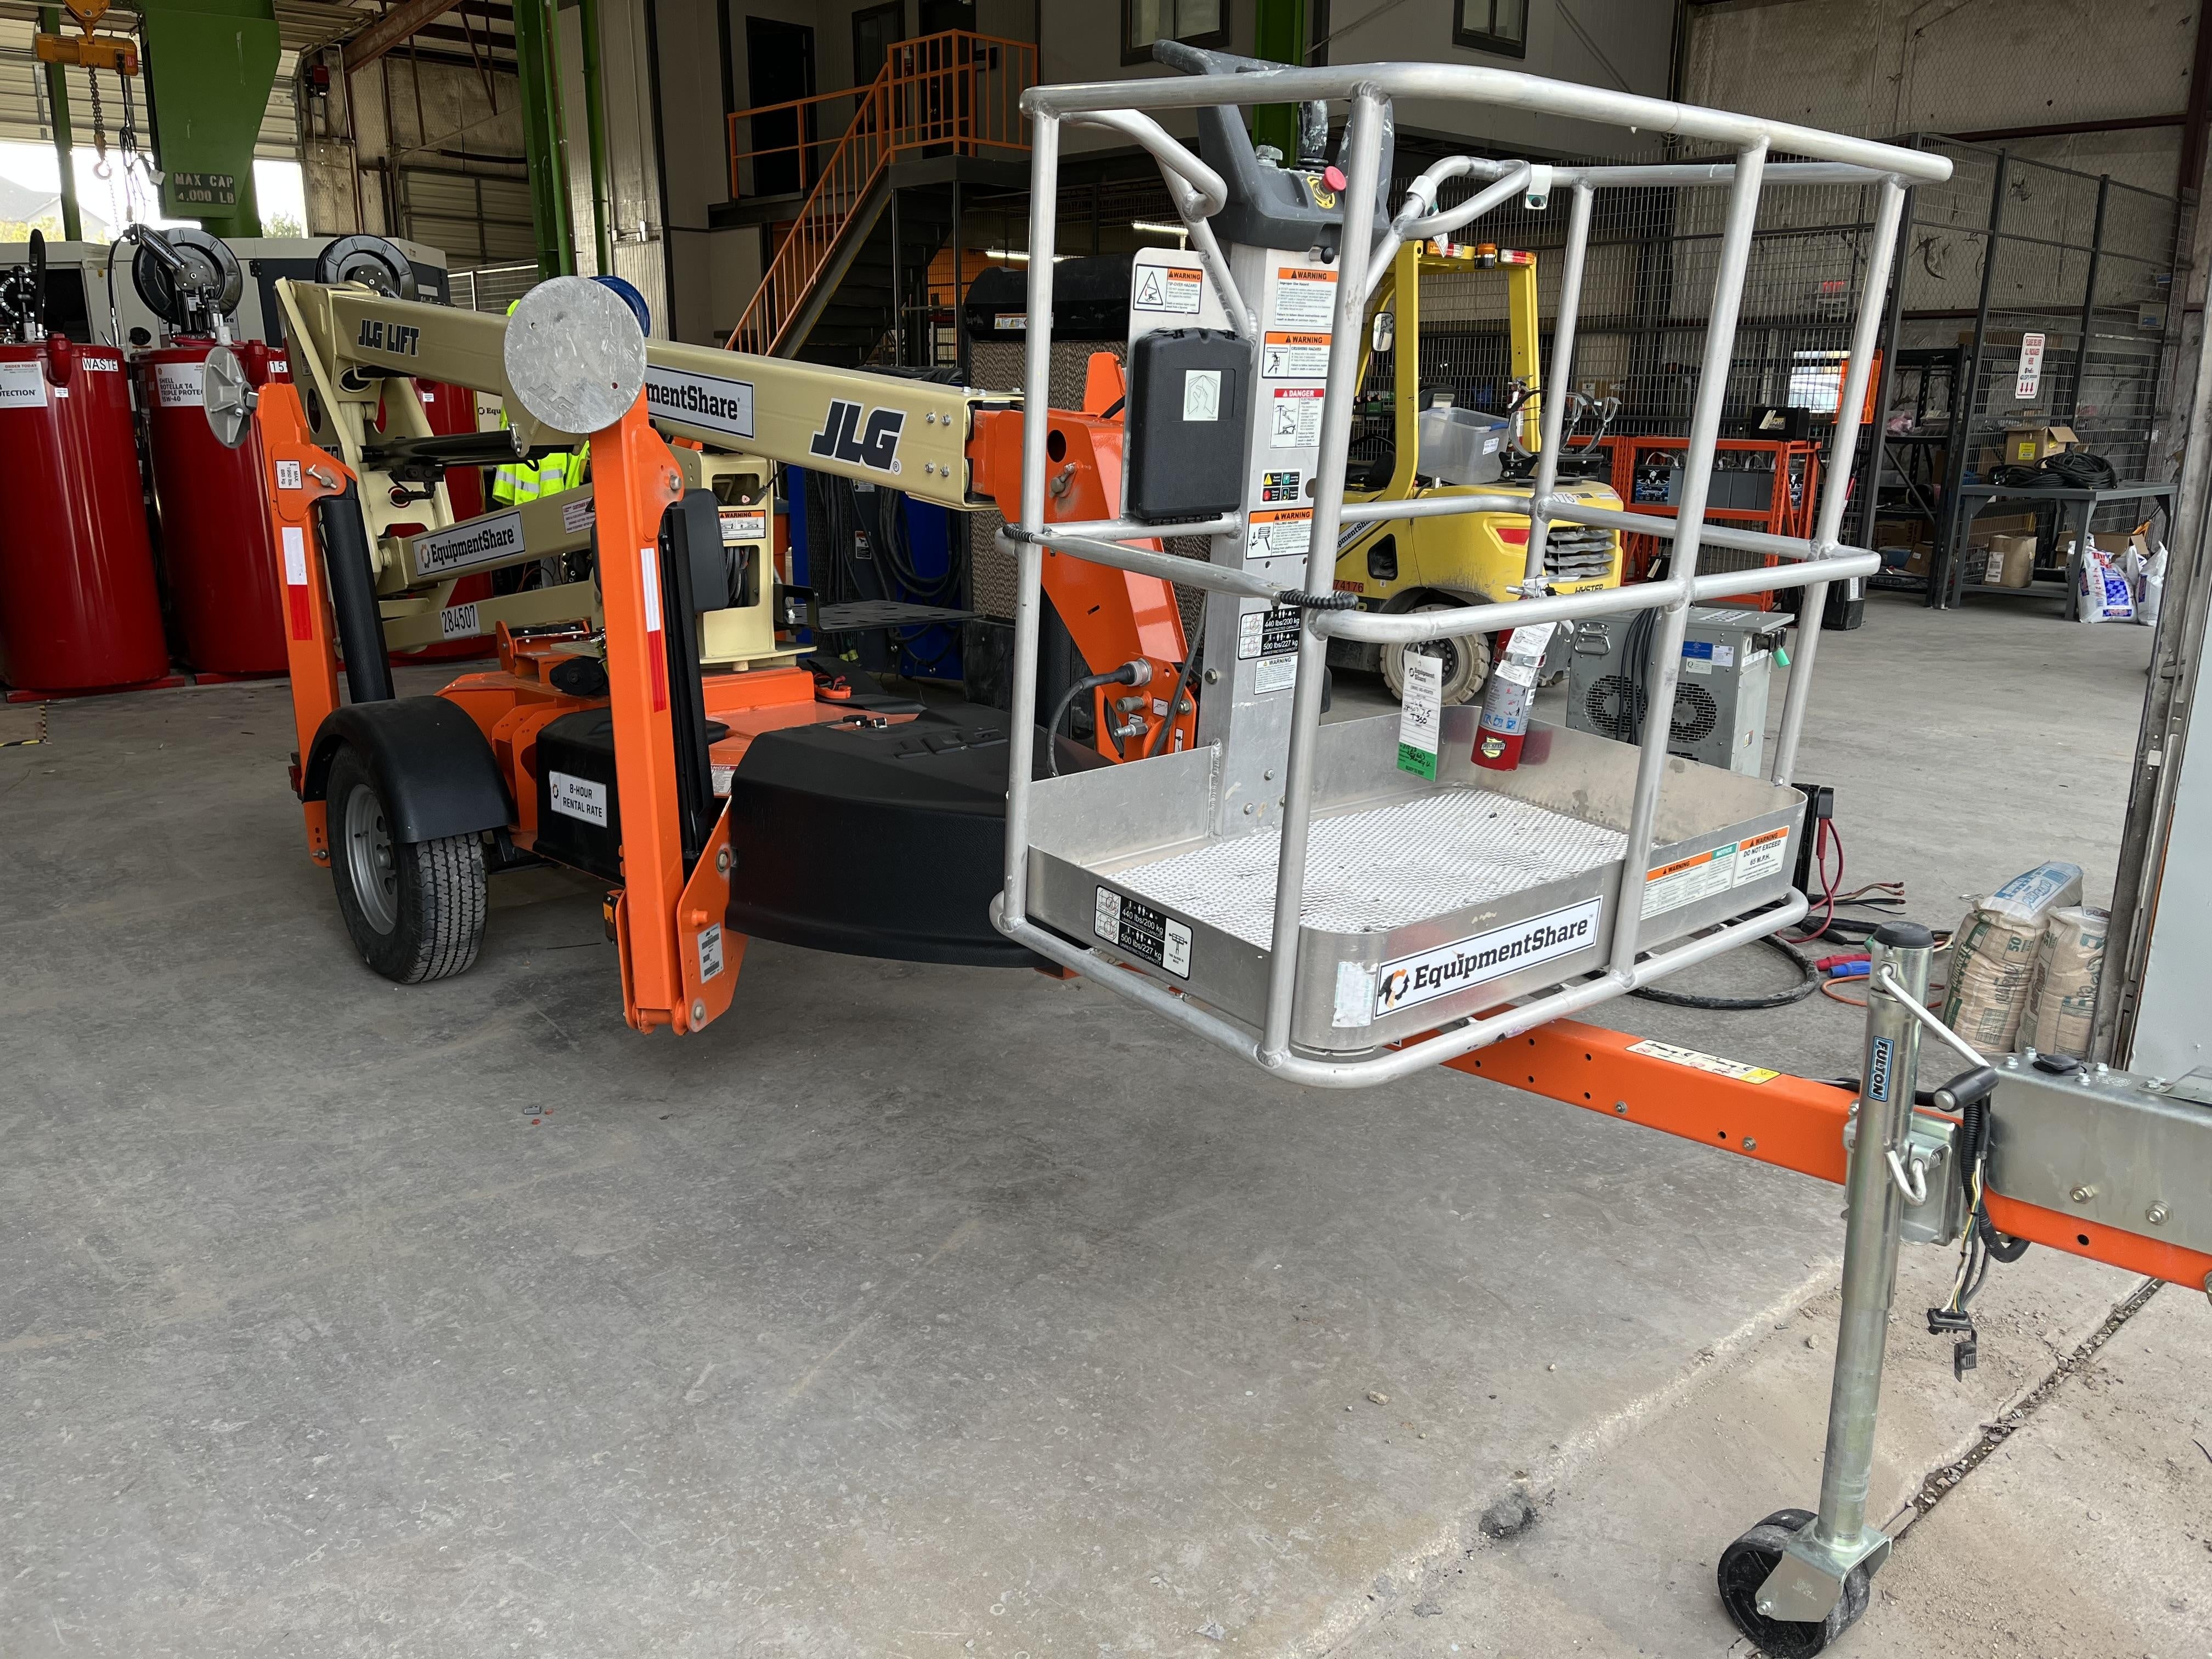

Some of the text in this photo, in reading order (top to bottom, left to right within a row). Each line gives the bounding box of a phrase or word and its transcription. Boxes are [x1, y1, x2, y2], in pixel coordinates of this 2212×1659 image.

[176, 173, 233, 187] MAX CAP
[219, 191, 234, 204] LB
[1298, 272, 1327, 280] WARNING
[358, 320, 420, 356] JLG LIFT
[83, 360, 117, 370] WASTE
[811, 401, 904, 470] JLG
[1281, 511, 1310, 520] WARNING
[430, 529, 515, 565] EquipmentShare
[442, 605, 476, 633] 284507
[570, 783, 592, 799] 8-HOUR
[563, 797, 602, 817] RENTAL RATE
[1751, 845, 1762, 854] NOT
[1762, 839, 1781, 850] EXCEED
[1756, 832, 1778, 845] WARNING
[1716, 847, 1733, 856] NOTICE
[1668, 861, 1690, 872] WARNING
[1750, 857, 1756, 866] 65
[1122, 909, 1163, 935] 440 lbs/200 kg
[1122, 917, 1164, 939] UNRESTRICTED CAPACITY
[1121, 934, 1131, 944] 500
[1133, 939, 1153, 954] lbs/227
[1154, 949, 1162, 961] kg
[2008, 936, 2022, 952] 50
[1120, 943, 1144, 957] UNRESTRICTED
[1145, 955, 1161, 966] CAPACITY
[1413, 919, 1588, 990] EquipmentShare
[1872, 1040, 1889, 1096] FULTON
